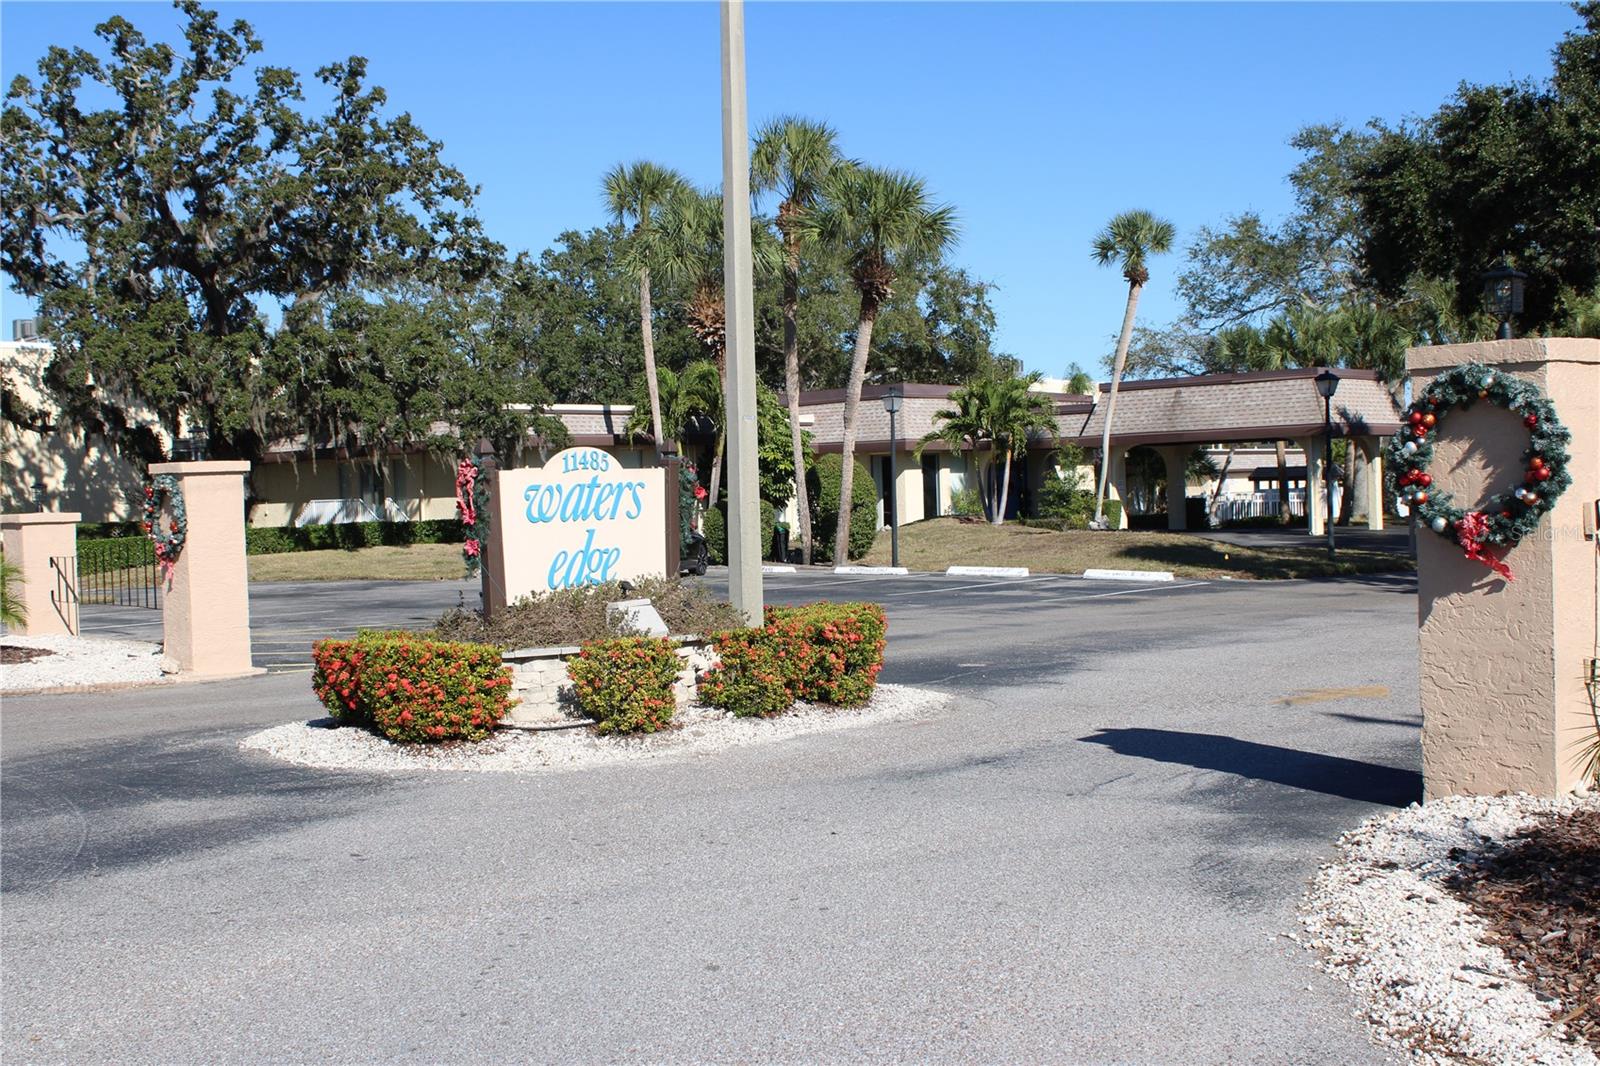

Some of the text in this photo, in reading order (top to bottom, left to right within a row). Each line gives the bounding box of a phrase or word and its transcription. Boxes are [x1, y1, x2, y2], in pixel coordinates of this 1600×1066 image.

[562, 450, 609, 473] 11485
[524, 475, 645, 523] waters
[548, 529, 620, 590] edge
